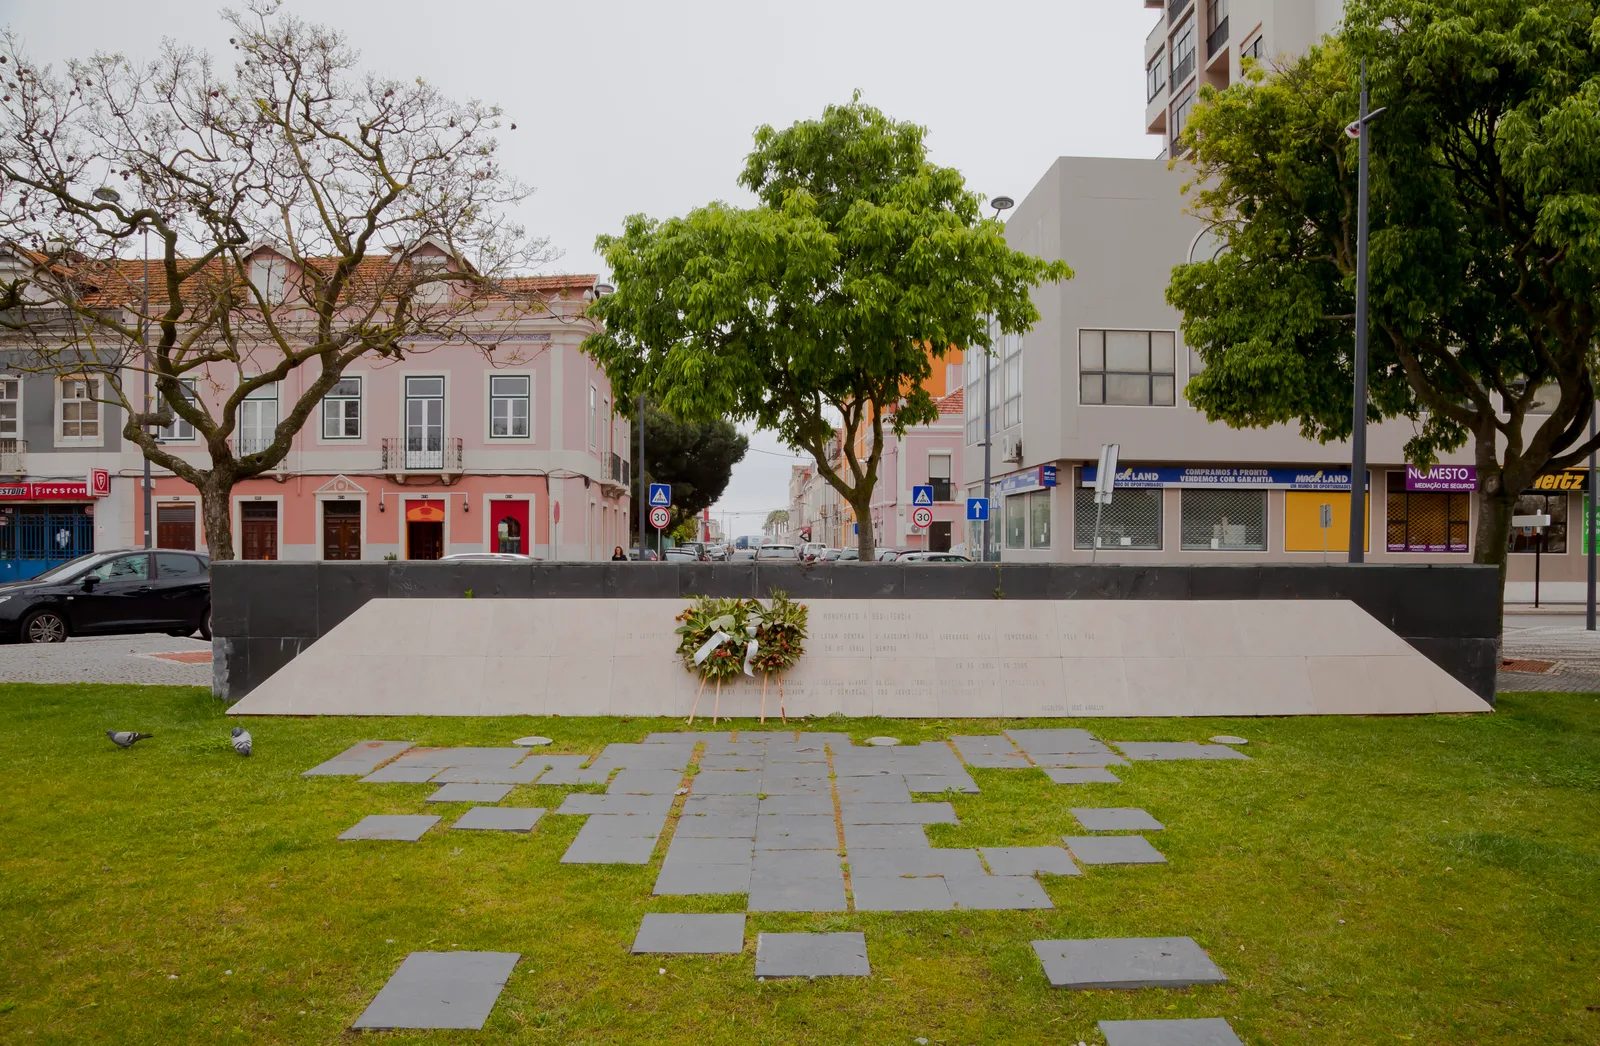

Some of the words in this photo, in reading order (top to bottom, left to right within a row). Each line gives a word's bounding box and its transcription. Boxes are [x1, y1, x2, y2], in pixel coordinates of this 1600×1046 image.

[1132, 472, 1159, 480] LAND
[1185, 468, 1231, 476] COMPRAMOS
[1408, 467, 1469, 480] NOMESTO
[1180, 475, 1218, 483] VENDEMOS
[1322, 475, 1348, 483] LAND
[34, 486, 86, 496] Fireston
[653, 512, 667, 522] 30
[916, 512, 930, 522] 30
[823, 612, 859, 620] MONUMENTO
